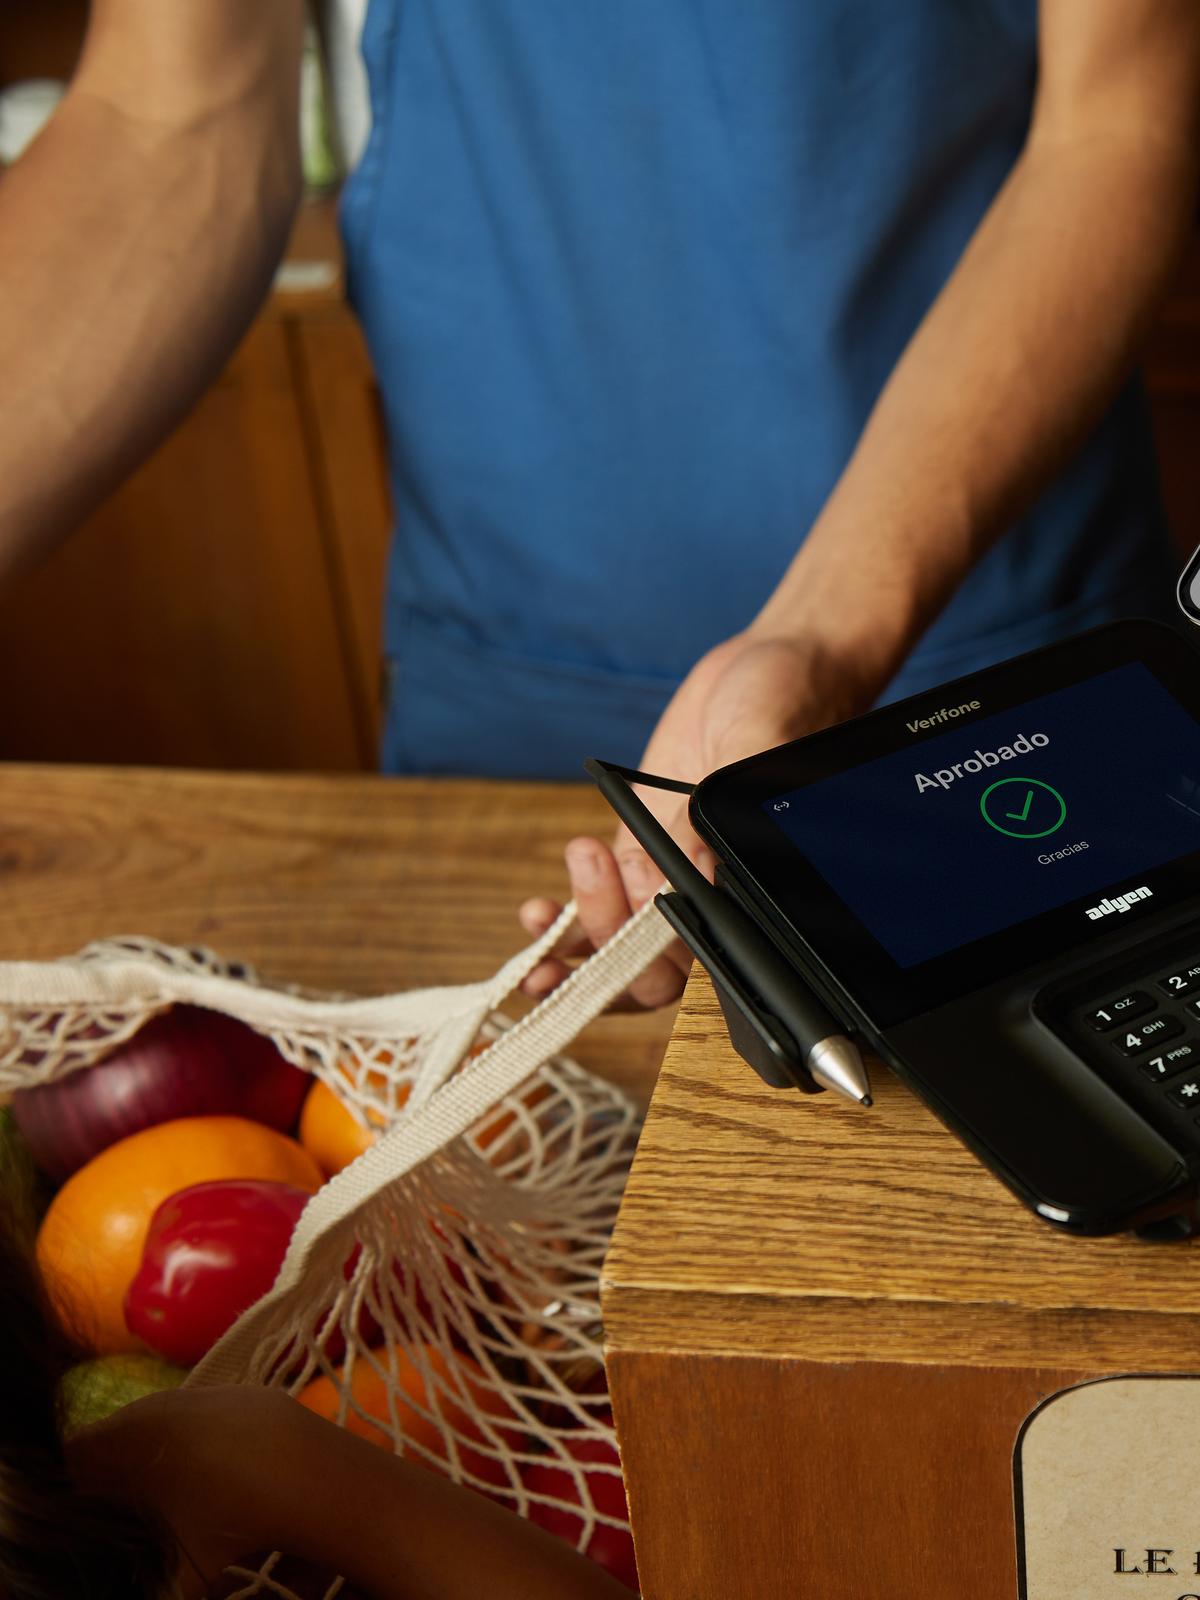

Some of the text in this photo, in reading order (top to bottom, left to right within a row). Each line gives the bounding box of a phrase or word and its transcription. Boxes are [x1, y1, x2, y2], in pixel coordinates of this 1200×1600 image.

[906, 699, 982, 733] Verifone
[914, 732, 1050, 793] Aprobado
[1037, 840, 1090, 866] Gracias
[1085, 886, 1154, 921] adyen
[1168, 976, 1188, 990] 2
[1096, 1010, 1112, 1022] 1
[1126, 1020, 1166, 1048] 4 GHI
[1148, 1046, 1192, 1073] 7 PRS
[1112, 1548, 1178, 1575] LE
